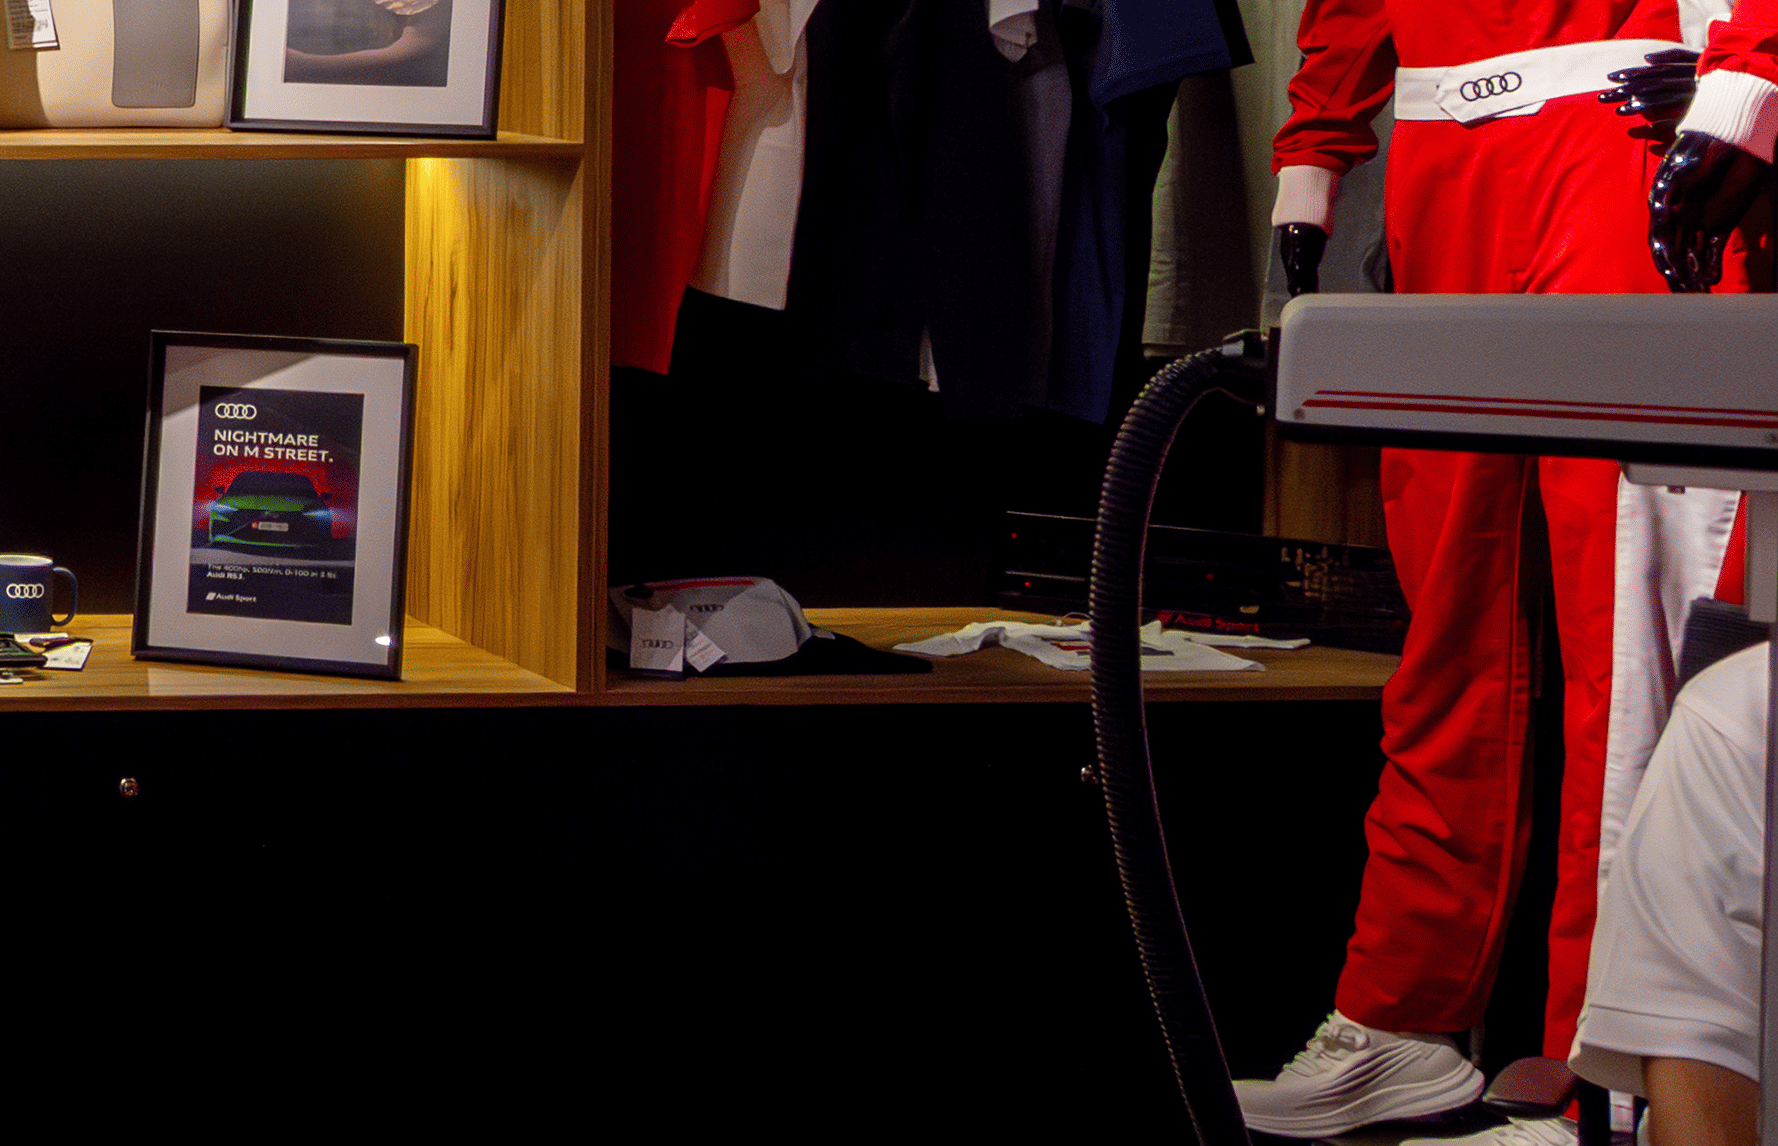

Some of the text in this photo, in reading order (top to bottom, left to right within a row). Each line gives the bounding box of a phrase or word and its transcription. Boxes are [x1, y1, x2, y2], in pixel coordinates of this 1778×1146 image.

[214, 429, 319, 447] NIGHTMARE
[213, 444, 334, 463] ON M STREET.
[235, 594, 257, 602] Sport
